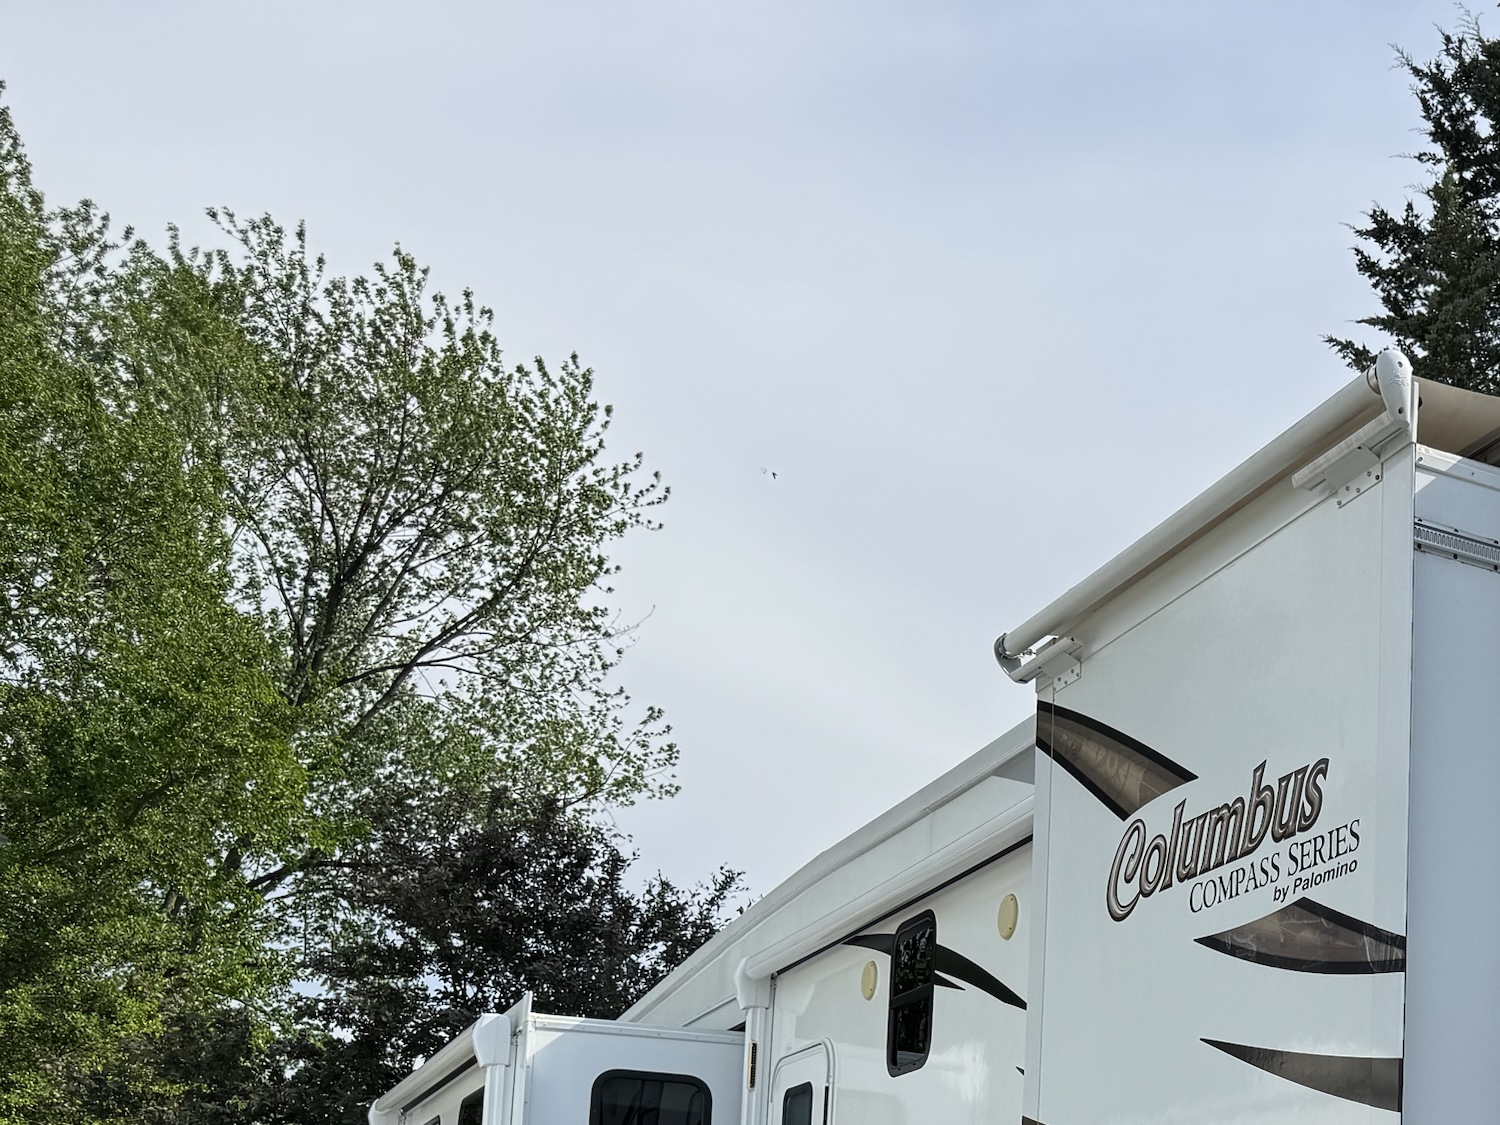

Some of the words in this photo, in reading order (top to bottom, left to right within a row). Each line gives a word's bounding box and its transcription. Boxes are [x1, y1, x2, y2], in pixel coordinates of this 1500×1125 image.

[1105, 757, 1330, 922] Columbus
[1188, 852, 1281, 914] COMPASS
[1286, 818, 1361, 878] SERIES
[1272, 886, 1290, 903] by
[1292, 859, 1359, 895] Palomino
